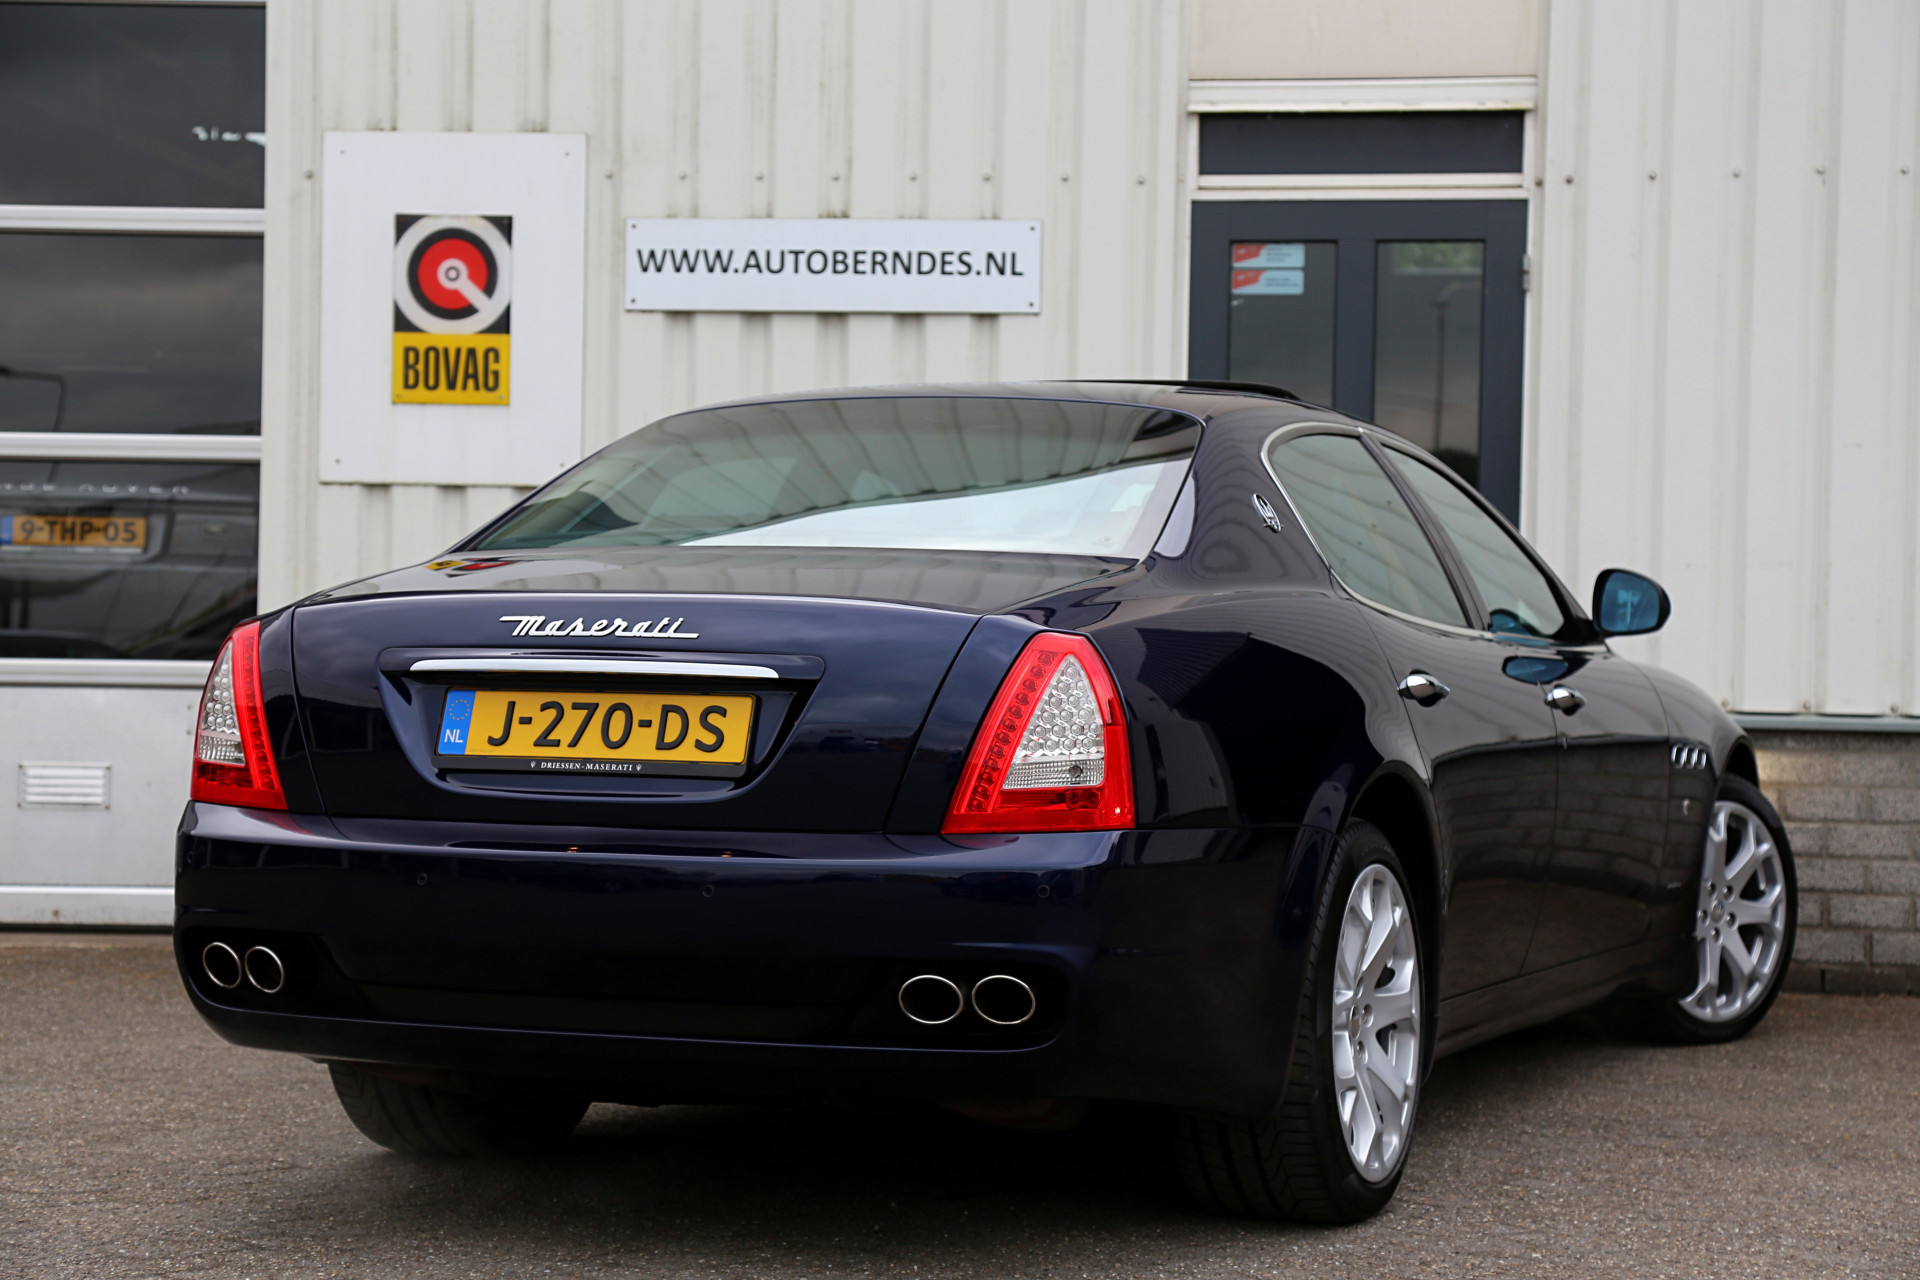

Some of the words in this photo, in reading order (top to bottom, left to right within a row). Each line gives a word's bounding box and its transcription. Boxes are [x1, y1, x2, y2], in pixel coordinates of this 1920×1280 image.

[636, 249, 1024, 277] WWW.AUTOBERNDES.NL
[403, 346, 500, 393] BOVAG
[20, 519, 137, 543] 9-THP-05
[498, 615, 700, 639] Maserati
[444, 729, 463, 744] NL
[487, 701, 727, 753] J-270-DS
